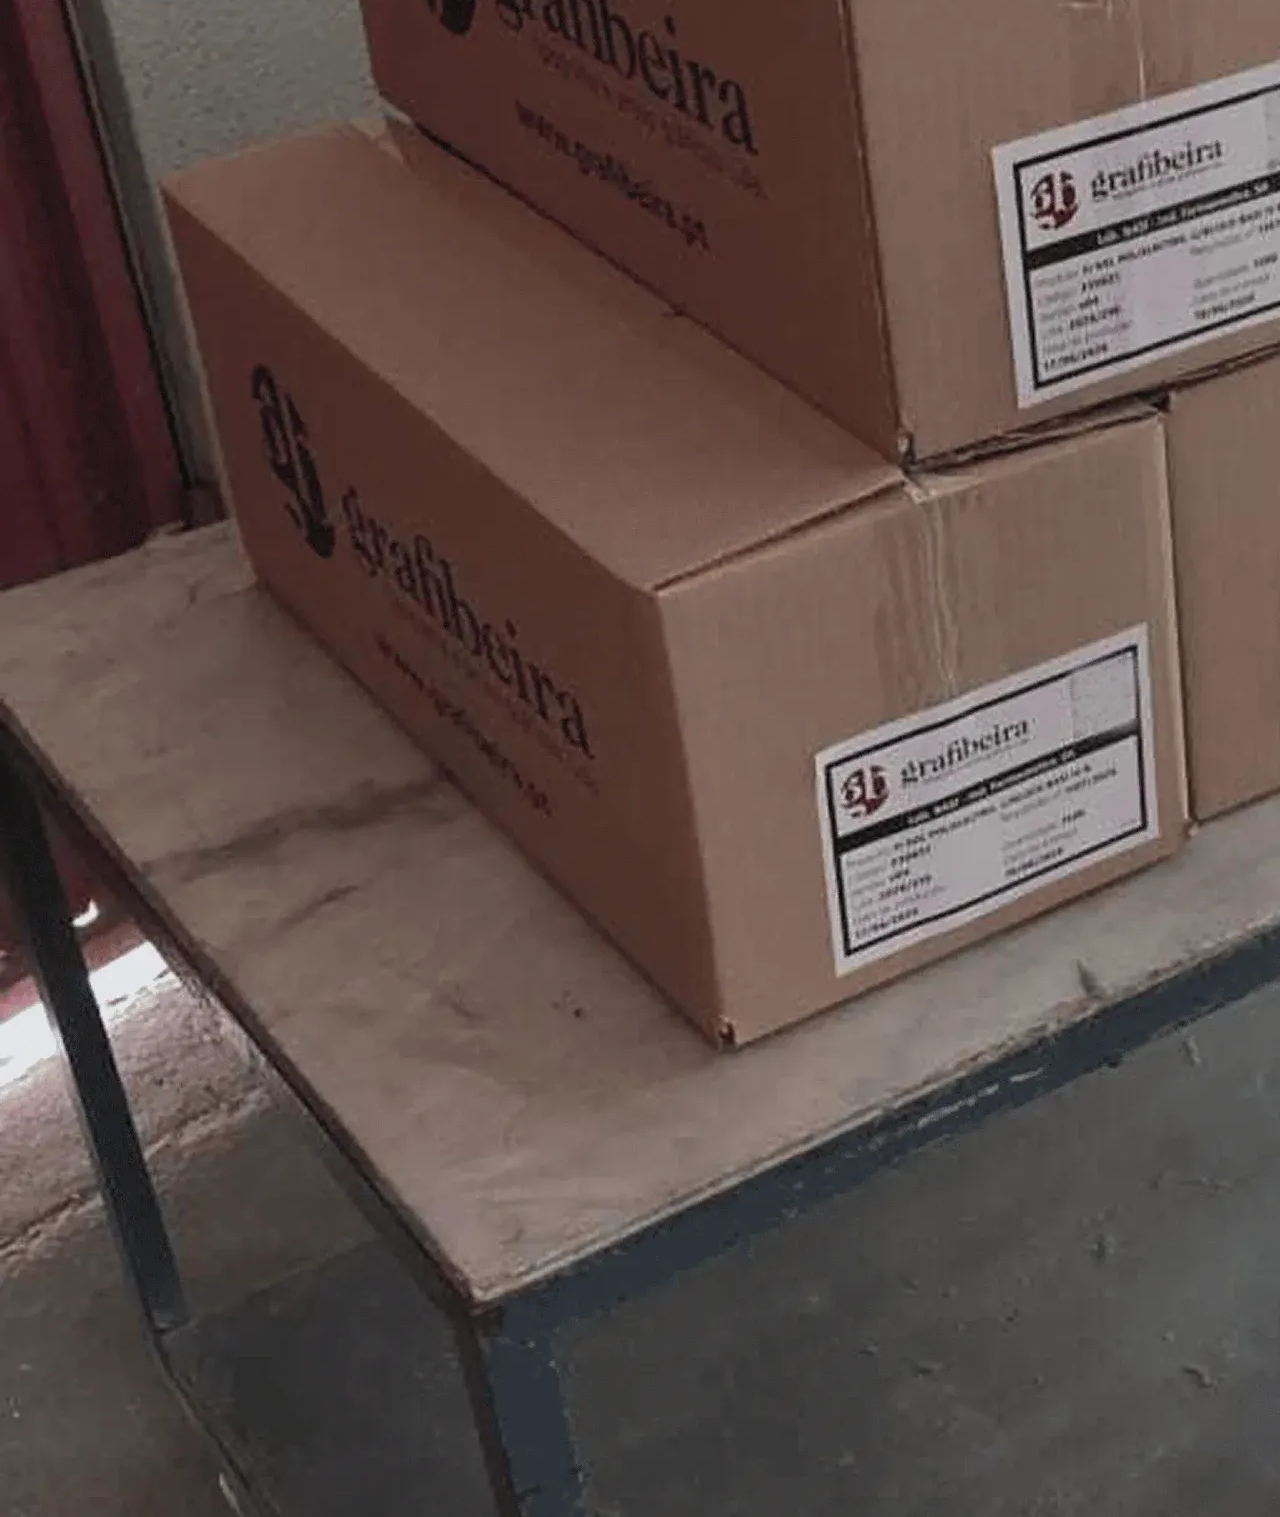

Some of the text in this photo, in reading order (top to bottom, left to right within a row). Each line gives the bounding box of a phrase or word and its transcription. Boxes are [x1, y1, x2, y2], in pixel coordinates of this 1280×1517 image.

[1090, 138, 1224, 202] grafibeira
[342, 486, 597, 761] grafibeira
[900, 718, 1031, 785] grafibeira
